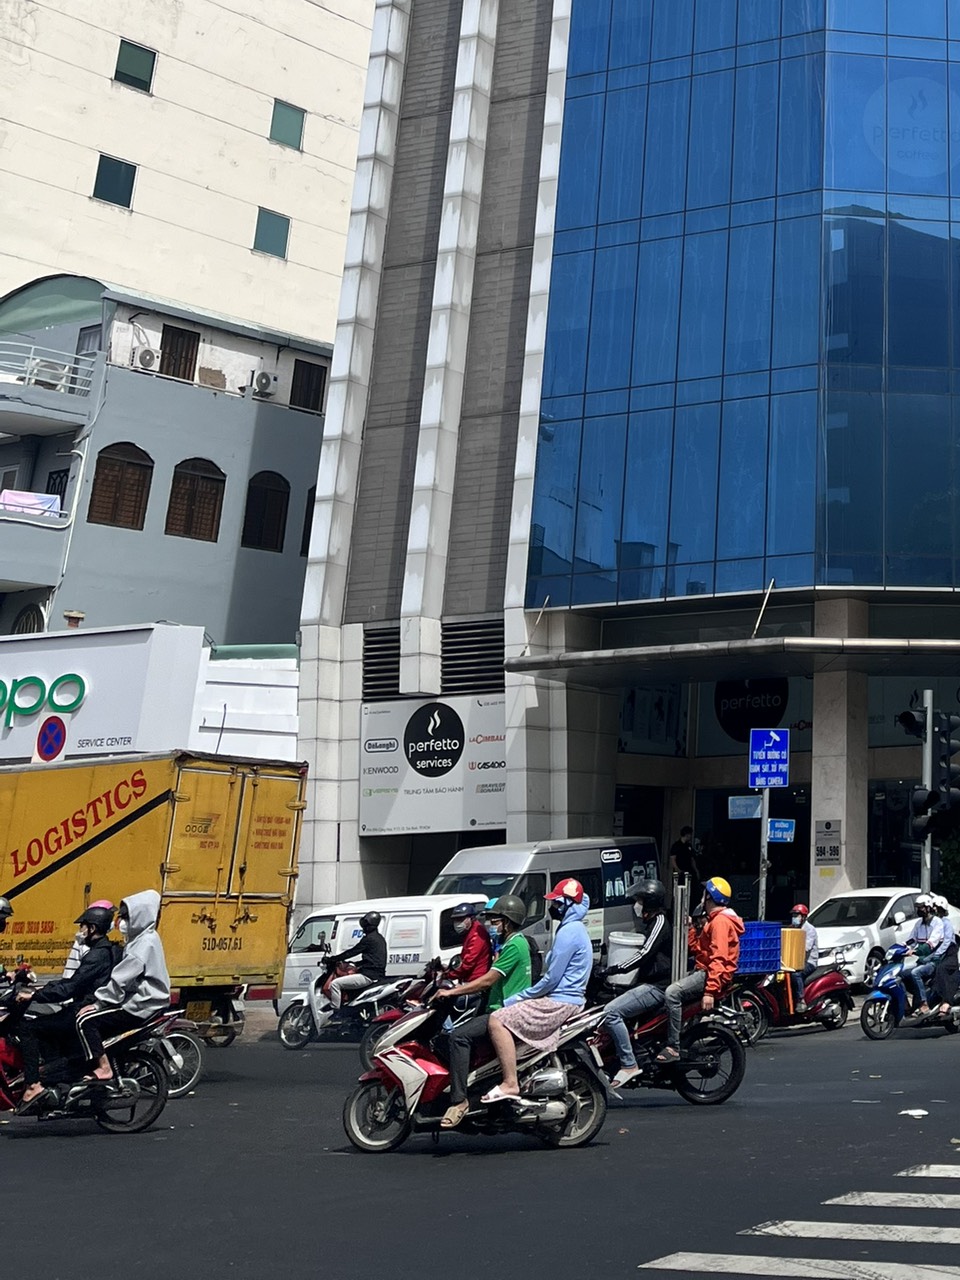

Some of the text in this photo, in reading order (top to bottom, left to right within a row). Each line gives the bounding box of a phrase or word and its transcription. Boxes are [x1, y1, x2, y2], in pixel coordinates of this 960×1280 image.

[896, 148, 940, 160] coffee
[0, 673, 86, 728] po
[720, 693, 782, 718] perfetto
[77, 736, 132, 748] SERVICE CENTER
[409, 738, 460, 758] perfetto
[416, 756, 453, 769] services
[363, 766, 399, 775] KENWOOD
[768, 777, 783, 786] CAMERA
[10, 769, 148, 878] LOGISTICS
